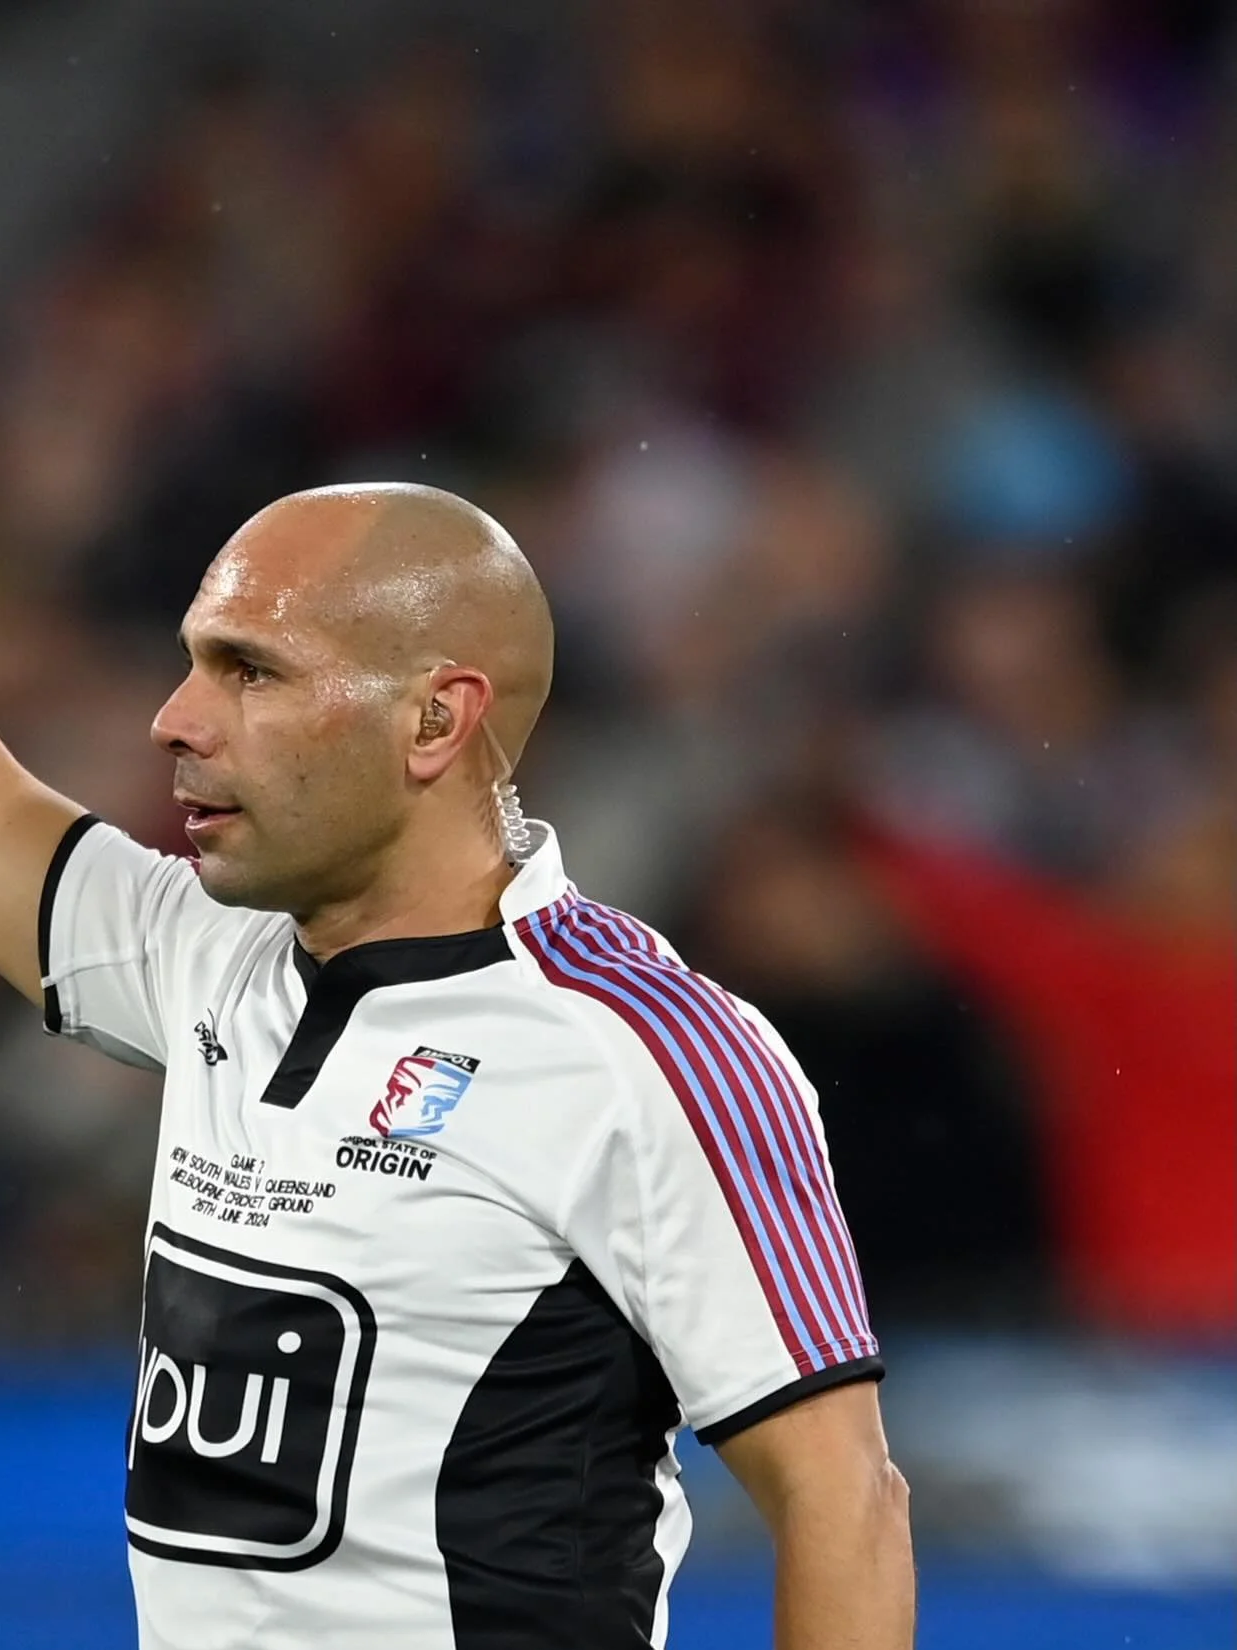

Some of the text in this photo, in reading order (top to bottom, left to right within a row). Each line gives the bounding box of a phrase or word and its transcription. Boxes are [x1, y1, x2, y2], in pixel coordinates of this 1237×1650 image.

[417, 1049, 473, 1071] AMPOL
[382, 1140, 417, 1156] STATE
[419, 1149, 438, 1161] OF
[169, 1146, 337, 1199] NEW SOUTH WALES V QUEENSLAND
[231, 1154, 257, 1173] GAME
[335, 1145, 433, 1181] ORIGIN
[169, 1166, 315, 1214] MELBOURNE CRICKET GROUND
[217, 1207, 243, 1225] JUNE
[244, 1212, 271, 1228] 2024
